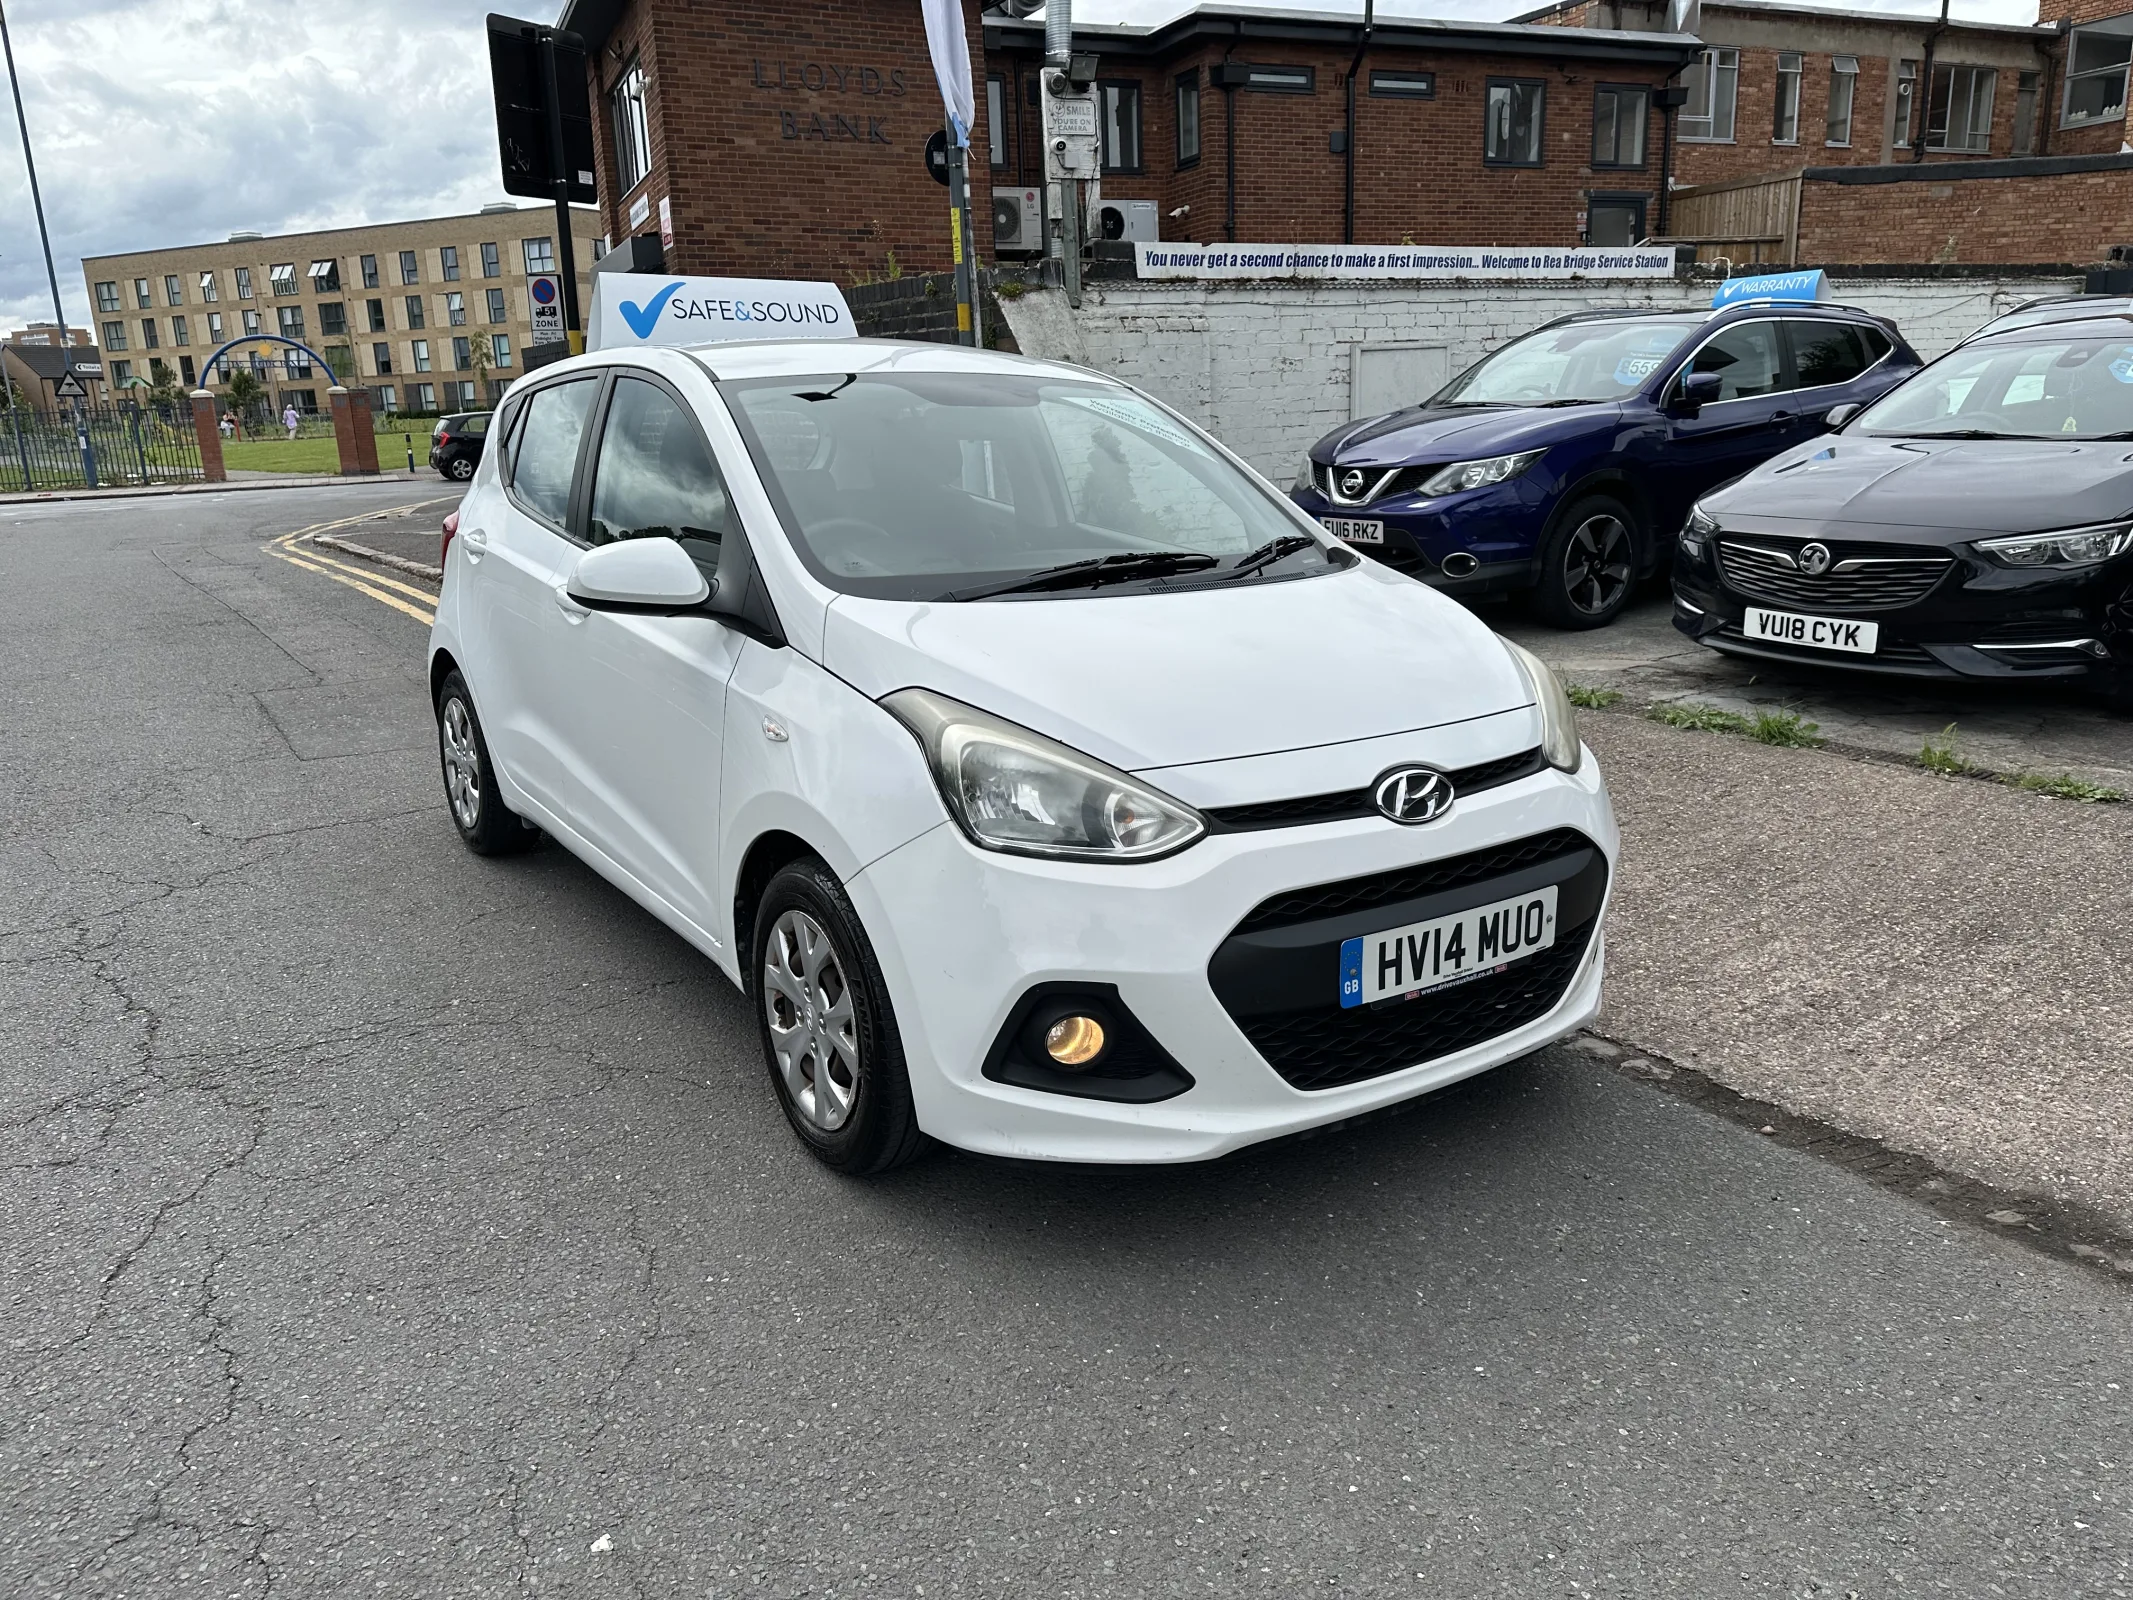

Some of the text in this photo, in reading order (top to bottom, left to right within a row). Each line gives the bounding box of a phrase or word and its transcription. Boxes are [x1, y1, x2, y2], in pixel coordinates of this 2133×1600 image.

[754, 57, 906, 96] LLOYDS
[1066, 106, 1091, 116] SMILE
[780, 110, 893, 144] BANK
[1145, 251, 1167, 267] You
[1170, 253, 1206, 267] never
[1207, 253, 1228, 268] get
[1230, 255, 1237, 267] a
[1239, 252, 1283, 268] second
[1286, 252, 1329, 268] chance
[1331, 254, 1343, 268] to
[1345, 253, 1376, 268] make
[1378, 256, 1385, 268] a
[1387, 253, 1411, 268] first
[1482, 254, 1529, 269] Welcome
[1531, 255, 1542, 268] to
[1543, 255, 1562, 268] Rea
[1563, 254, 1596, 270] Bridge
[1598, 254, 1633, 268] Service
[1634, 255, 1669, 268] Station
[1741, 276, 1814, 294] WARRANTY
[535, 320, 559, 328] ZONE
[672, 298, 839, 324] SAFE&SOUND
[1089, 399, 1190, 443] Warranty Protection
[1353, 522, 1379, 540] RKZ
[1759, 612, 1861, 647] VU18 CYK
[1378, 899, 1544, 991] HV14 MUO
[1344, 979, 1359, 994] GB
[1420, 968, 1494, 996] www.drivevauxhall.co.uk
